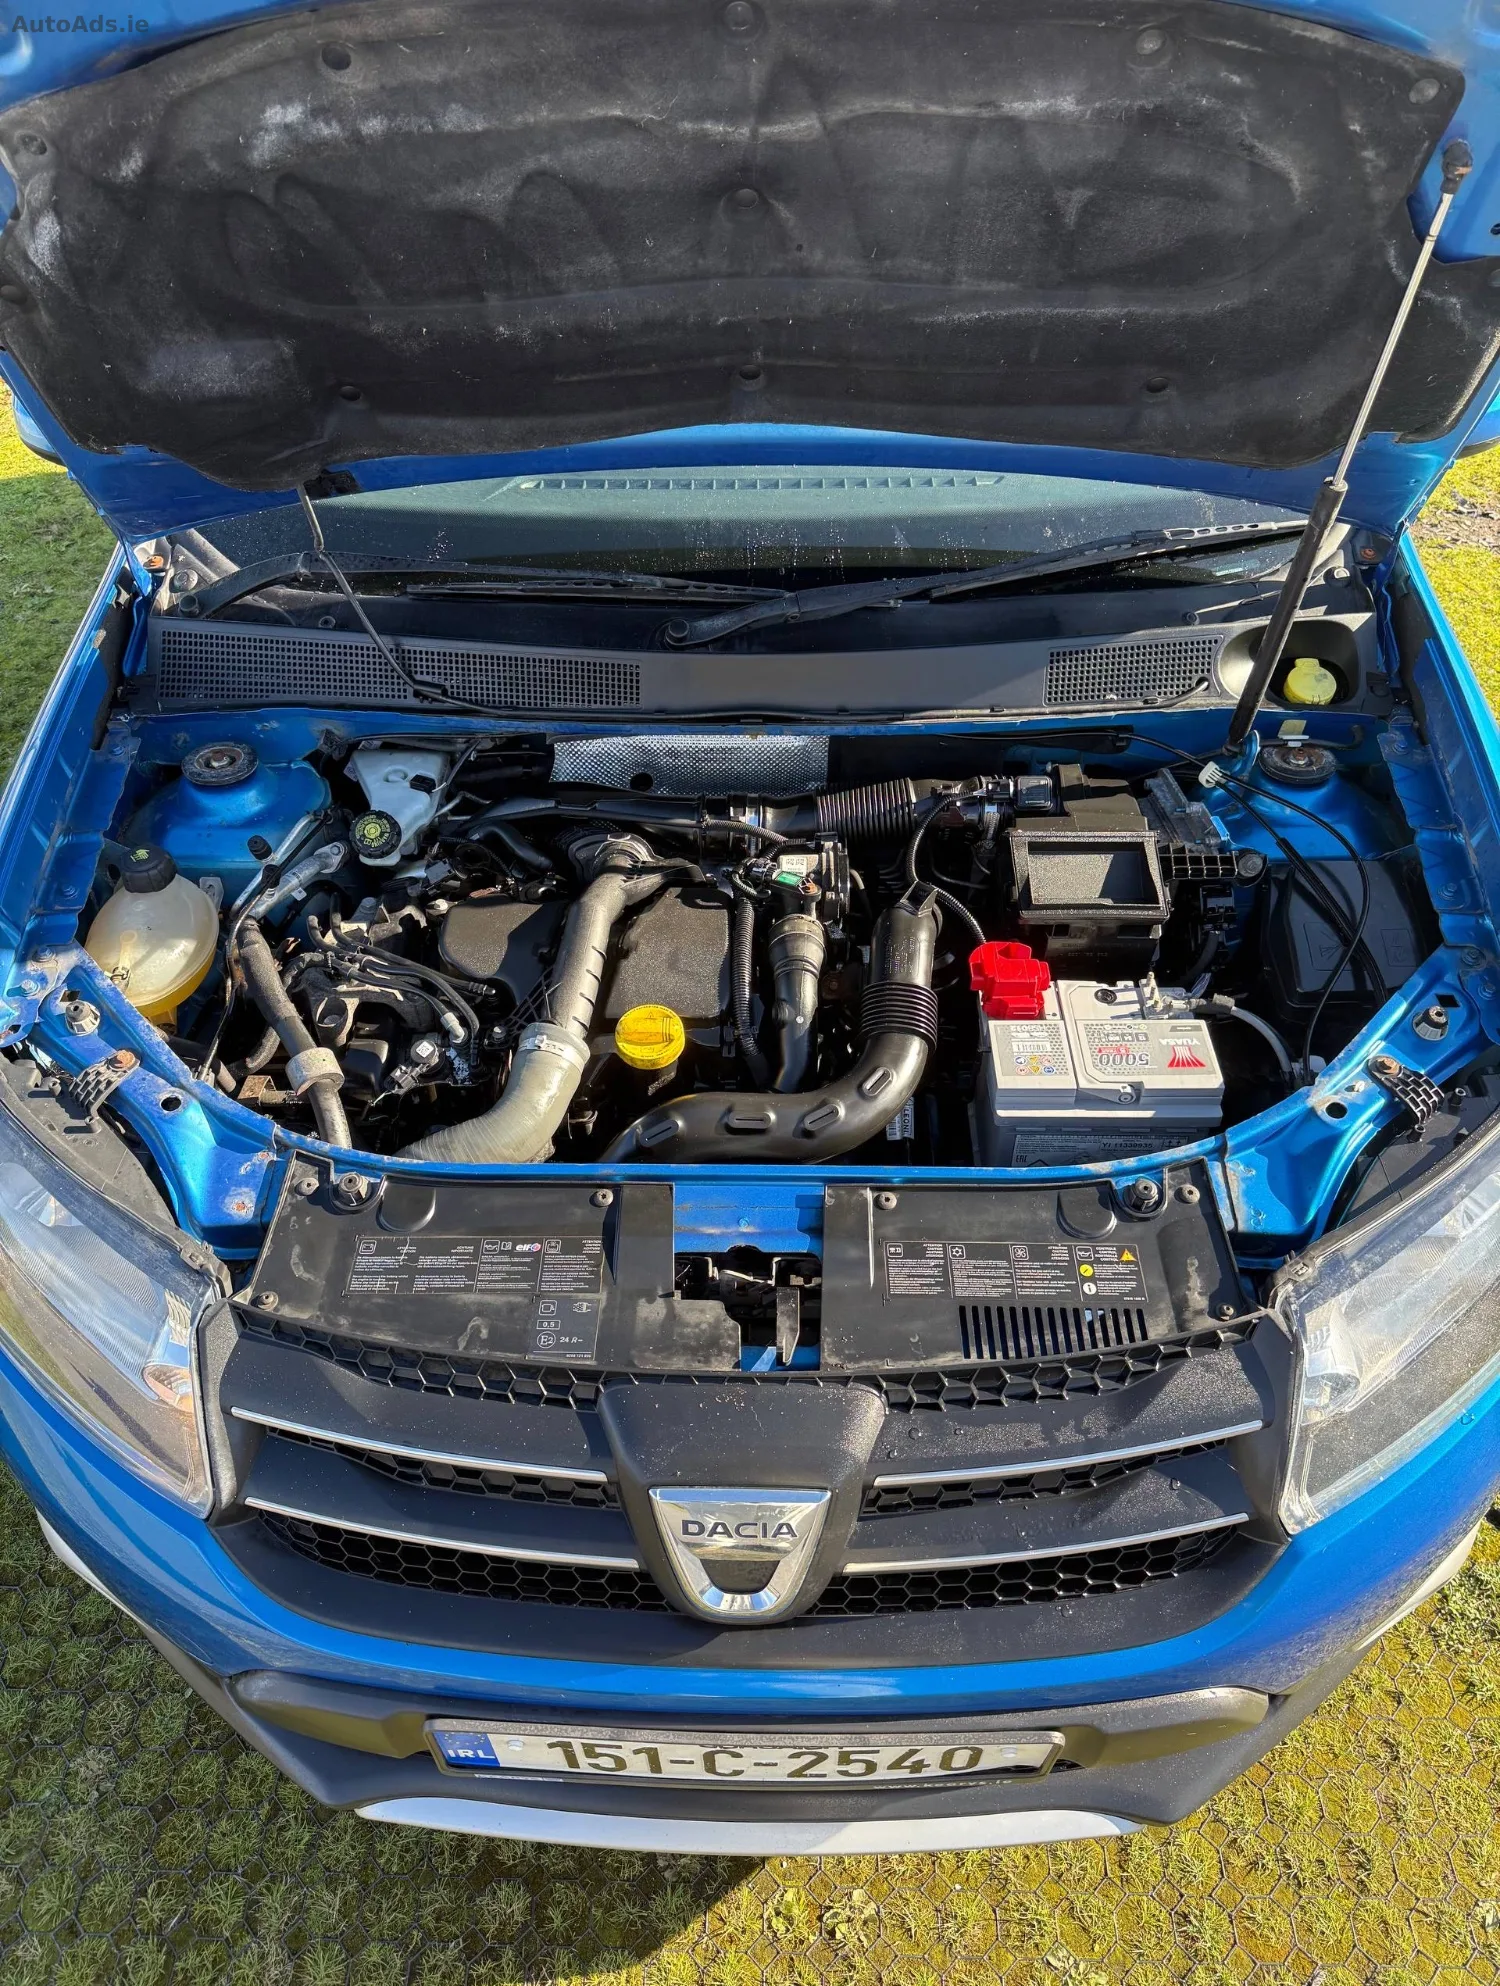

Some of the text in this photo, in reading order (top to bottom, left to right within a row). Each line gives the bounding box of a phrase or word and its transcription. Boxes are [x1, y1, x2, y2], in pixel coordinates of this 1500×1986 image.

[1099, 1053, 1149, 1066] 5000
[681, 1520, 798, 1539] DACIA
[448, 1750, 496, 1759] IRL
[547, 1740, 984, 1778] 151-C-2540
